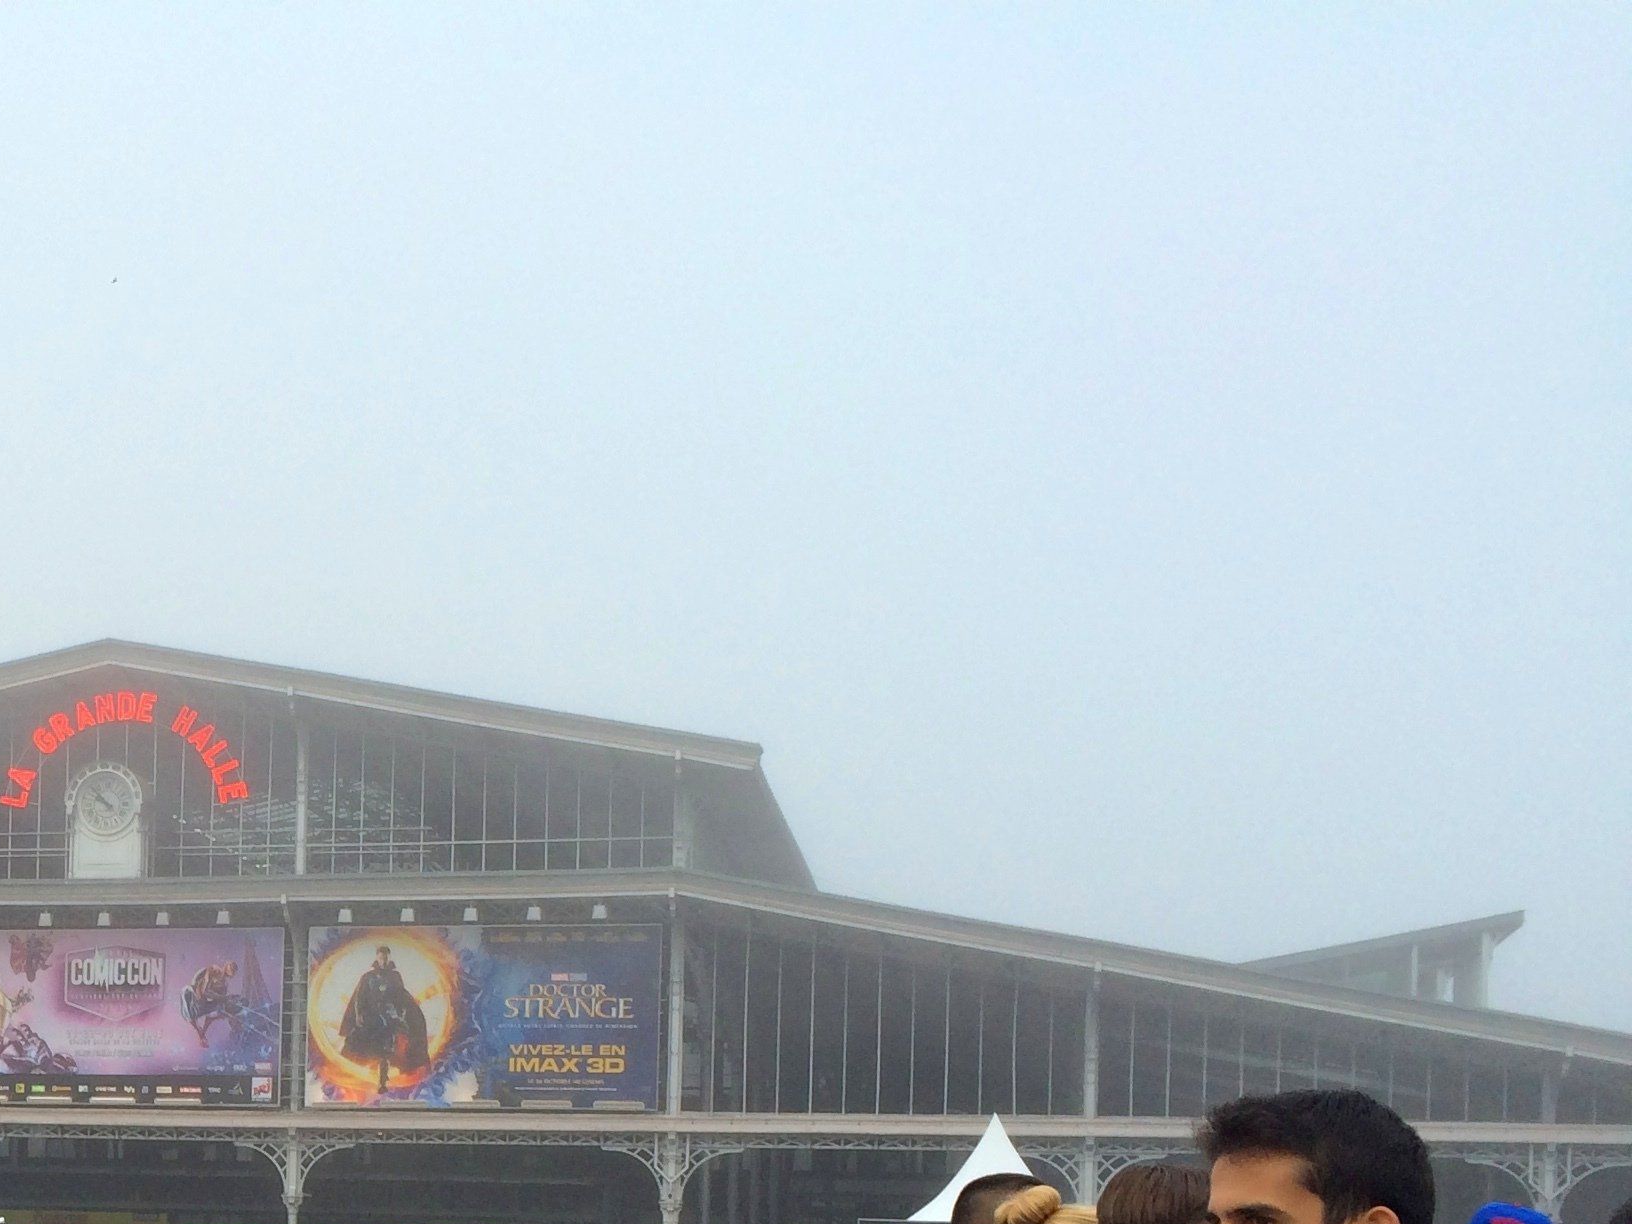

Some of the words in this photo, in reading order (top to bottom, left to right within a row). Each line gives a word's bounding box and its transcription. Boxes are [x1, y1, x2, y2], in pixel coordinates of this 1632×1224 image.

[32, 692, 158, 754] GRANDE
[171, 705, 248, 804] HALLE
[529, 983, 607, 997] DOCTOR
[503, 997, 635, 1019] STRANGE
[509, 1044, 593, 1056] VIVEZ-LE
[599, 1044, 626, 1056] EN
[508, 1057, 580, 1073] IMAX
[586, 1057, 625, 1074] 3D
